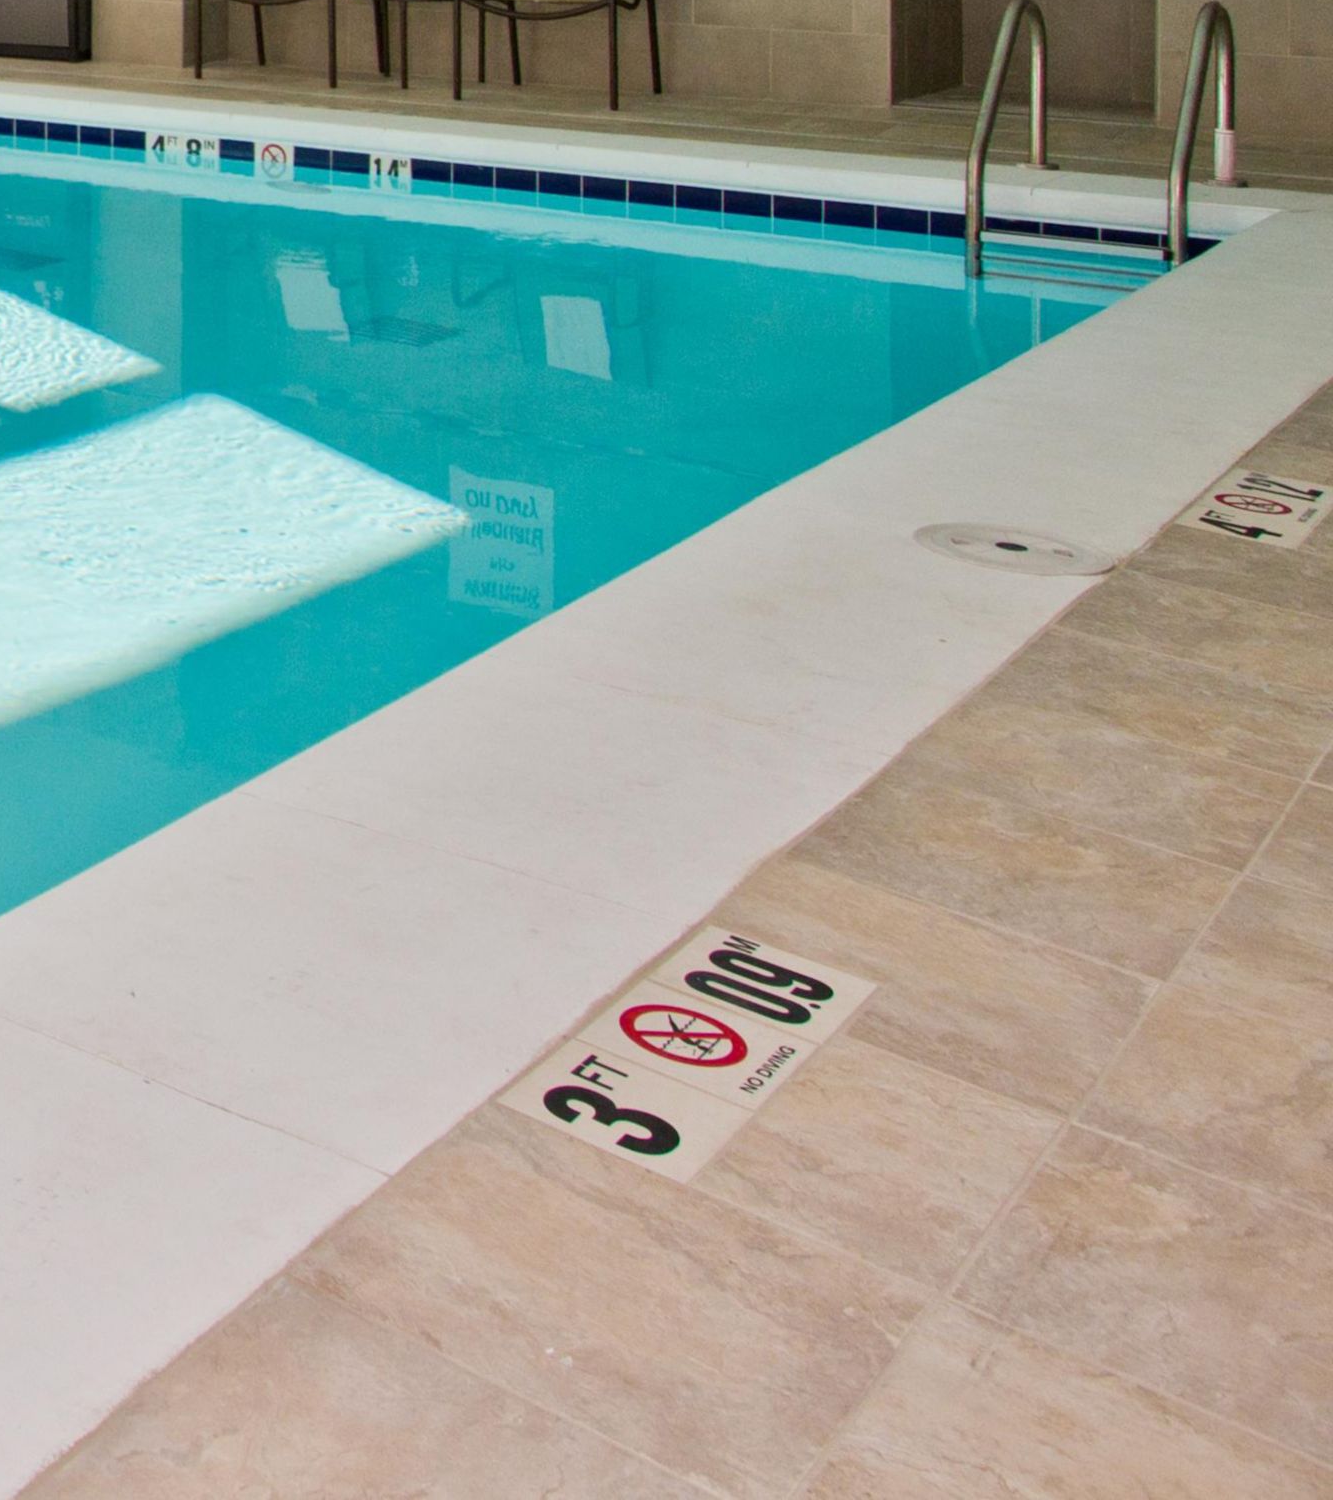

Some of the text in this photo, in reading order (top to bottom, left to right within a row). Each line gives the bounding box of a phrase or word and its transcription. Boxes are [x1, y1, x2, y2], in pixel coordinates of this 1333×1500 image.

[167, 136, 178, 146] FT
[204, 140, 215, 150] IN
[739, 1046, 796, 1094] NO DIVING
[543, 1054, 681, 1155] 3 FT
